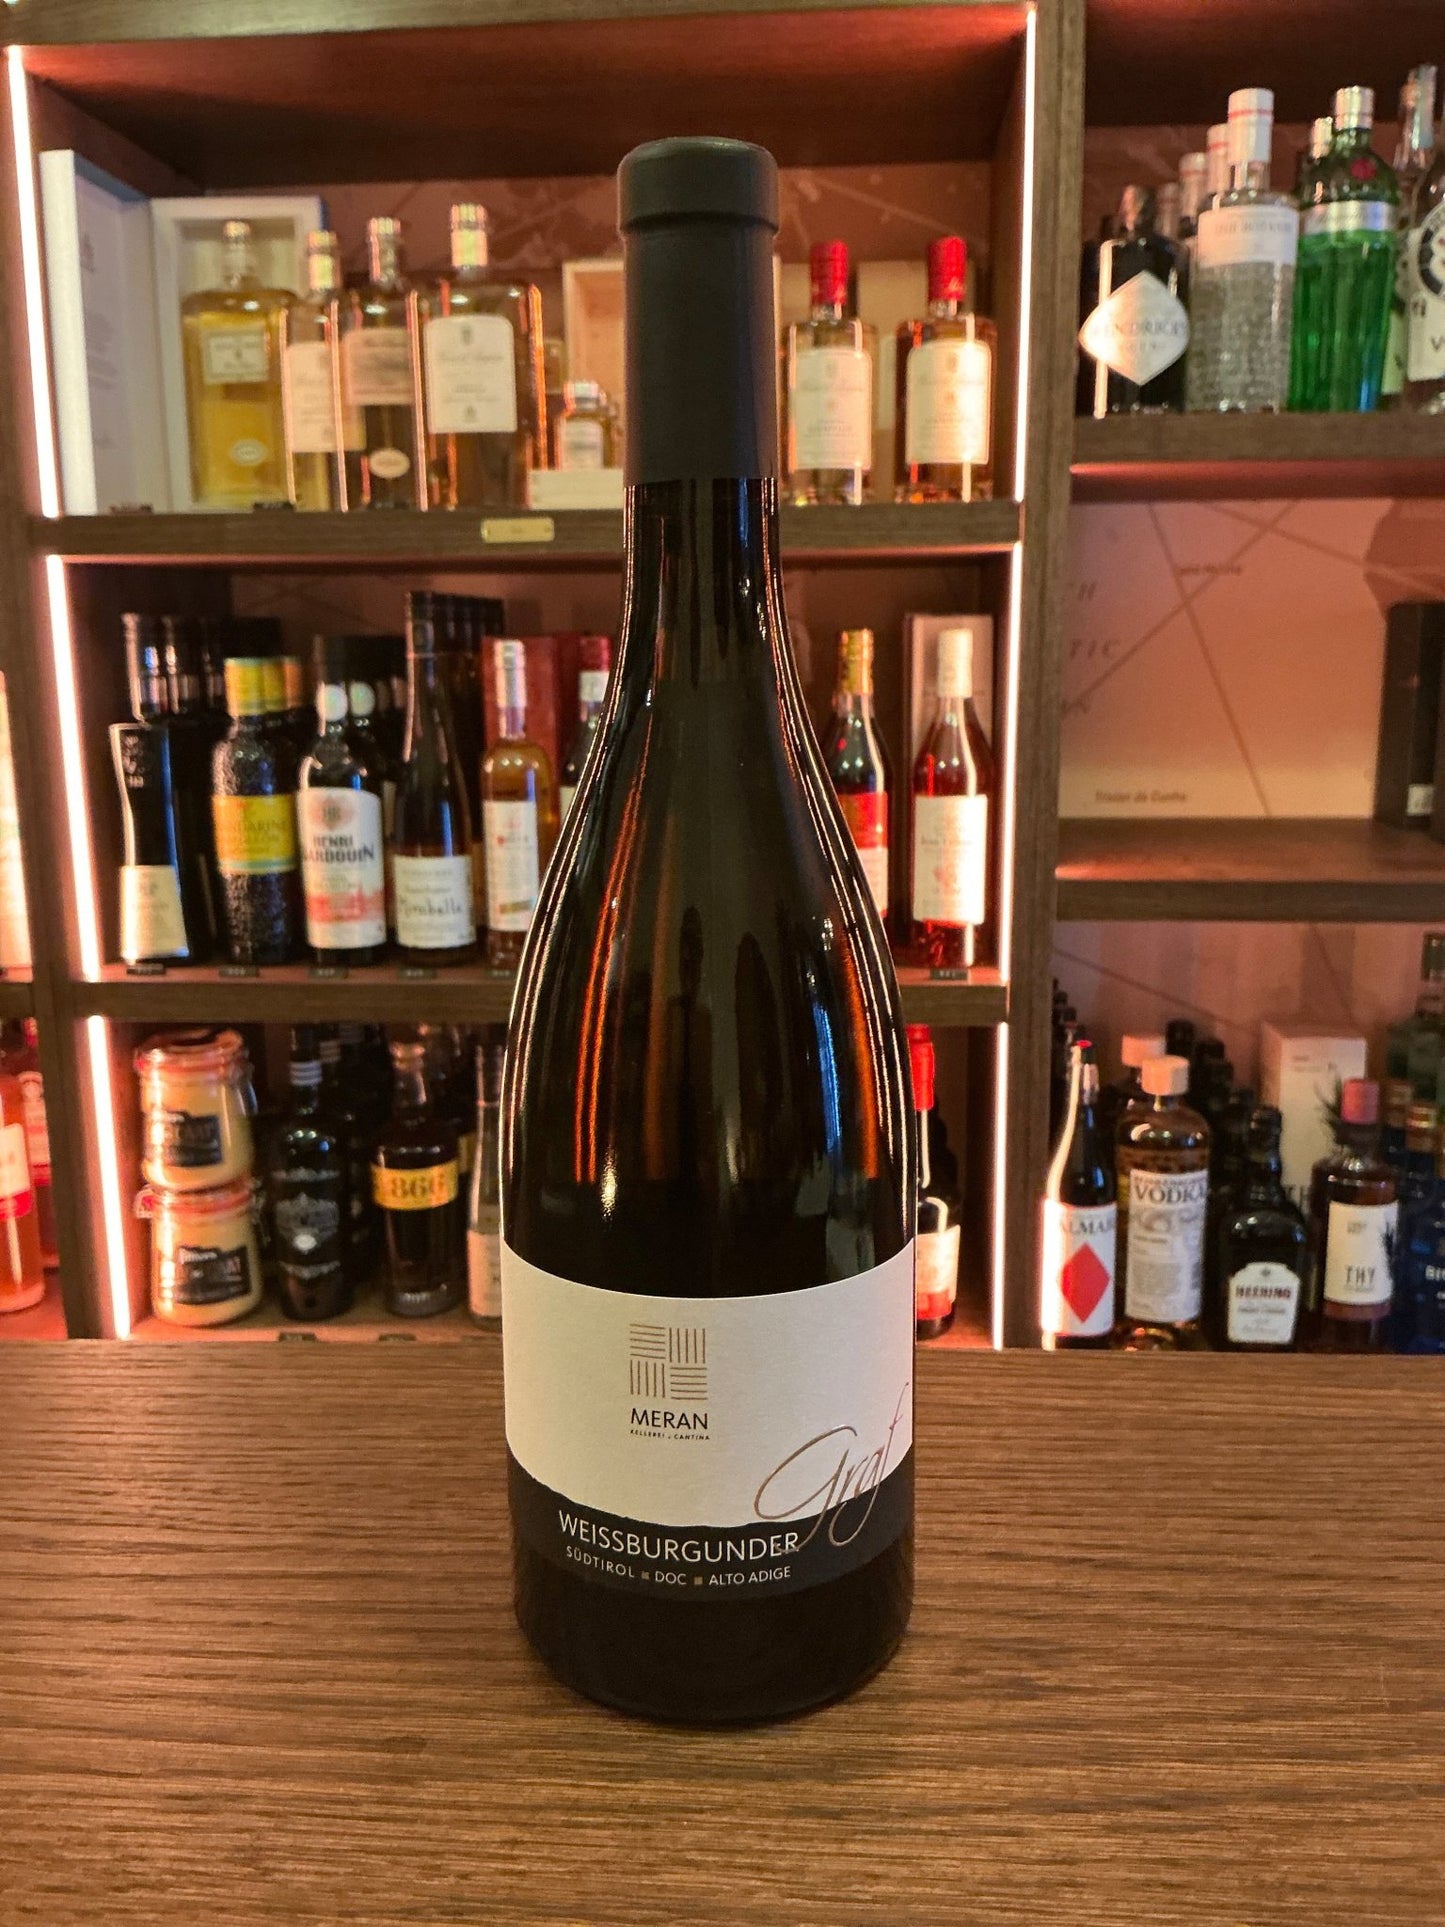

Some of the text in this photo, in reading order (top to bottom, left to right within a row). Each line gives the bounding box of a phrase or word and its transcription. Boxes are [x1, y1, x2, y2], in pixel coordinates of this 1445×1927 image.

[631, 1407, 708, 1430] MERAN
[630, 1429, 710, 1441] KELLEREI CANTINA
[558, 1509, 800, 1563] WEISSBURGUNDER
[566, 1545, 792, 1586] SÜDTIROL DOC ALTO ADIGE
